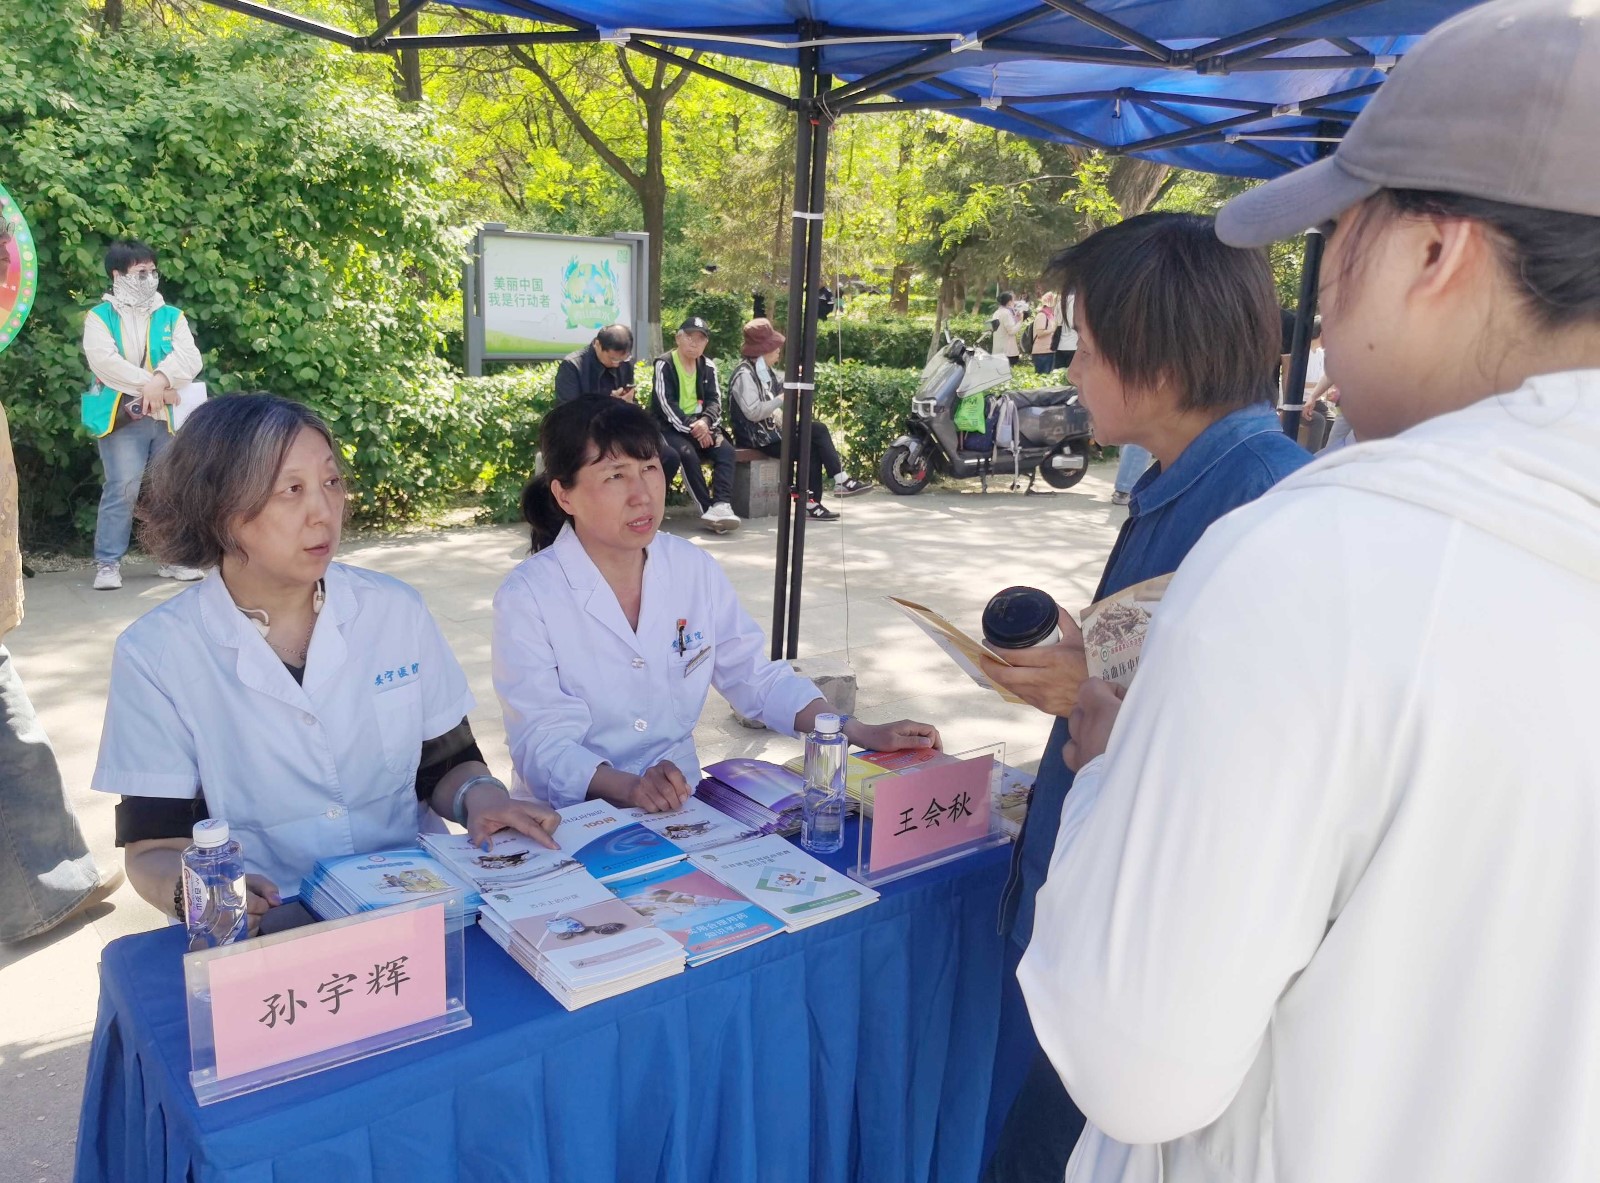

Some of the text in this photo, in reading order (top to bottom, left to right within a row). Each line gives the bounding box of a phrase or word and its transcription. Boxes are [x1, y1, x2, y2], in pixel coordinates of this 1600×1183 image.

[493, 277, 543, 292] 美丽中国
[488, 292, 551, 308] 我是行动者
[671, 631, 704, 648] 安医院
[583, 816, 617, 829] 100问
[893, 791, 973, 837] 王会秋
[194, 887, 202, 911] 百岁山
[685, 911, 748, 936] 实用合理用药
[704, 923, 747, 939] 知识手册
[258, 955, 411, 1029] 孙宇辉
